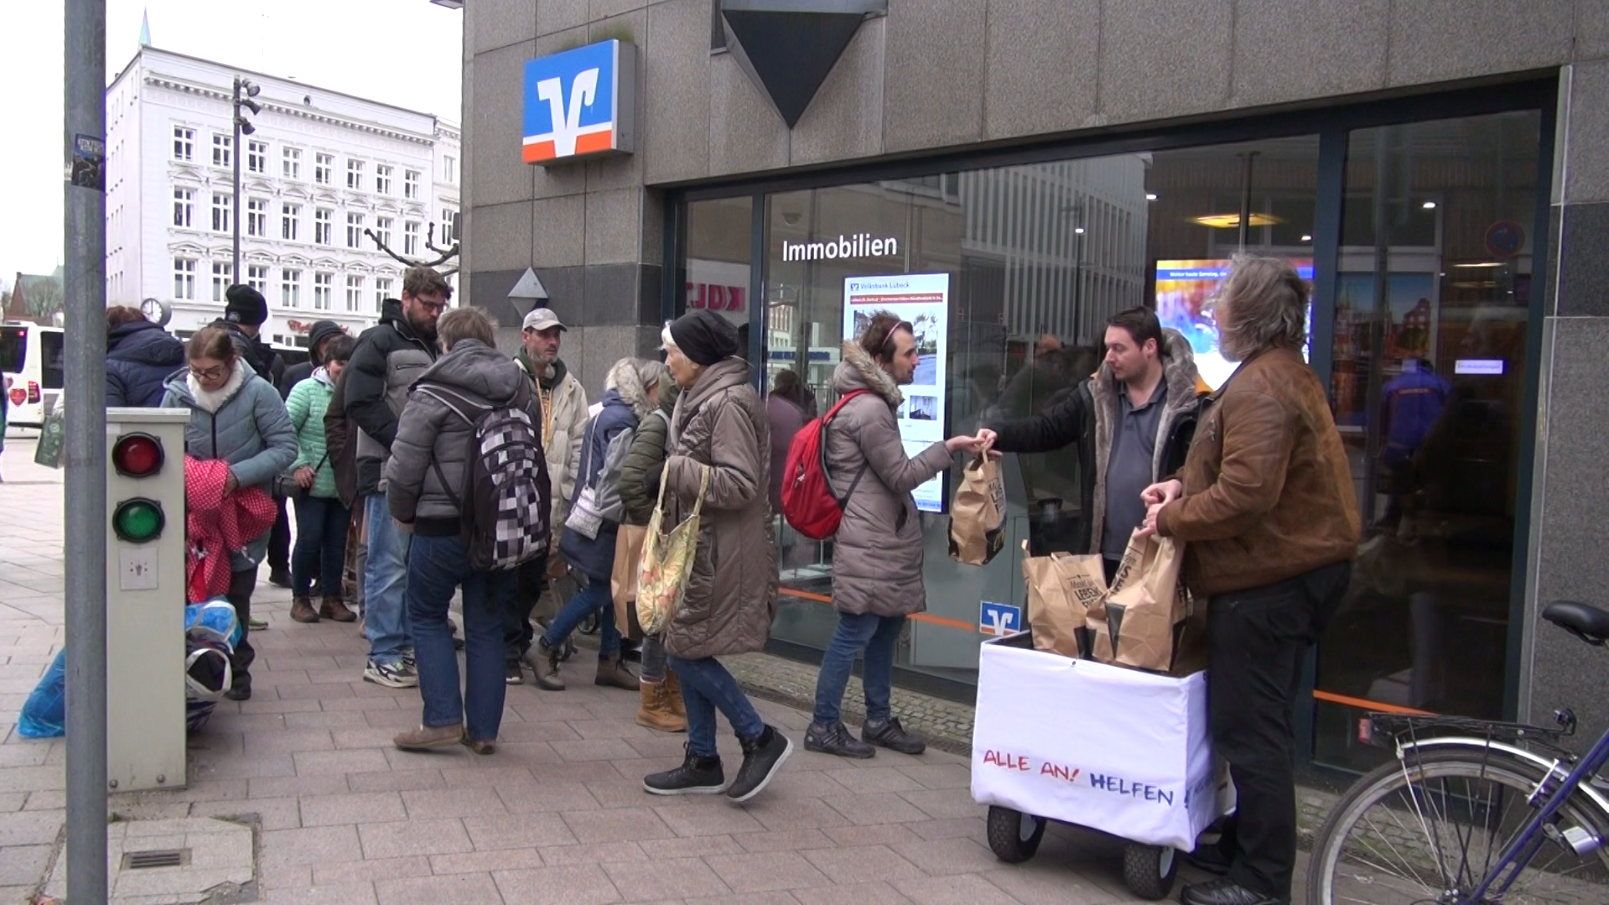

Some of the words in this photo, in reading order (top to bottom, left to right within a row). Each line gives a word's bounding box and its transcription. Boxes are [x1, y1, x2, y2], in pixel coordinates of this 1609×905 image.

[782, 233, 898, 262] Immobilien
[983, 749, 1031, 771] ALLE
[1040, 761, 1080, 783] AN!
[1089, 772, 1174, 806] HELFEN
